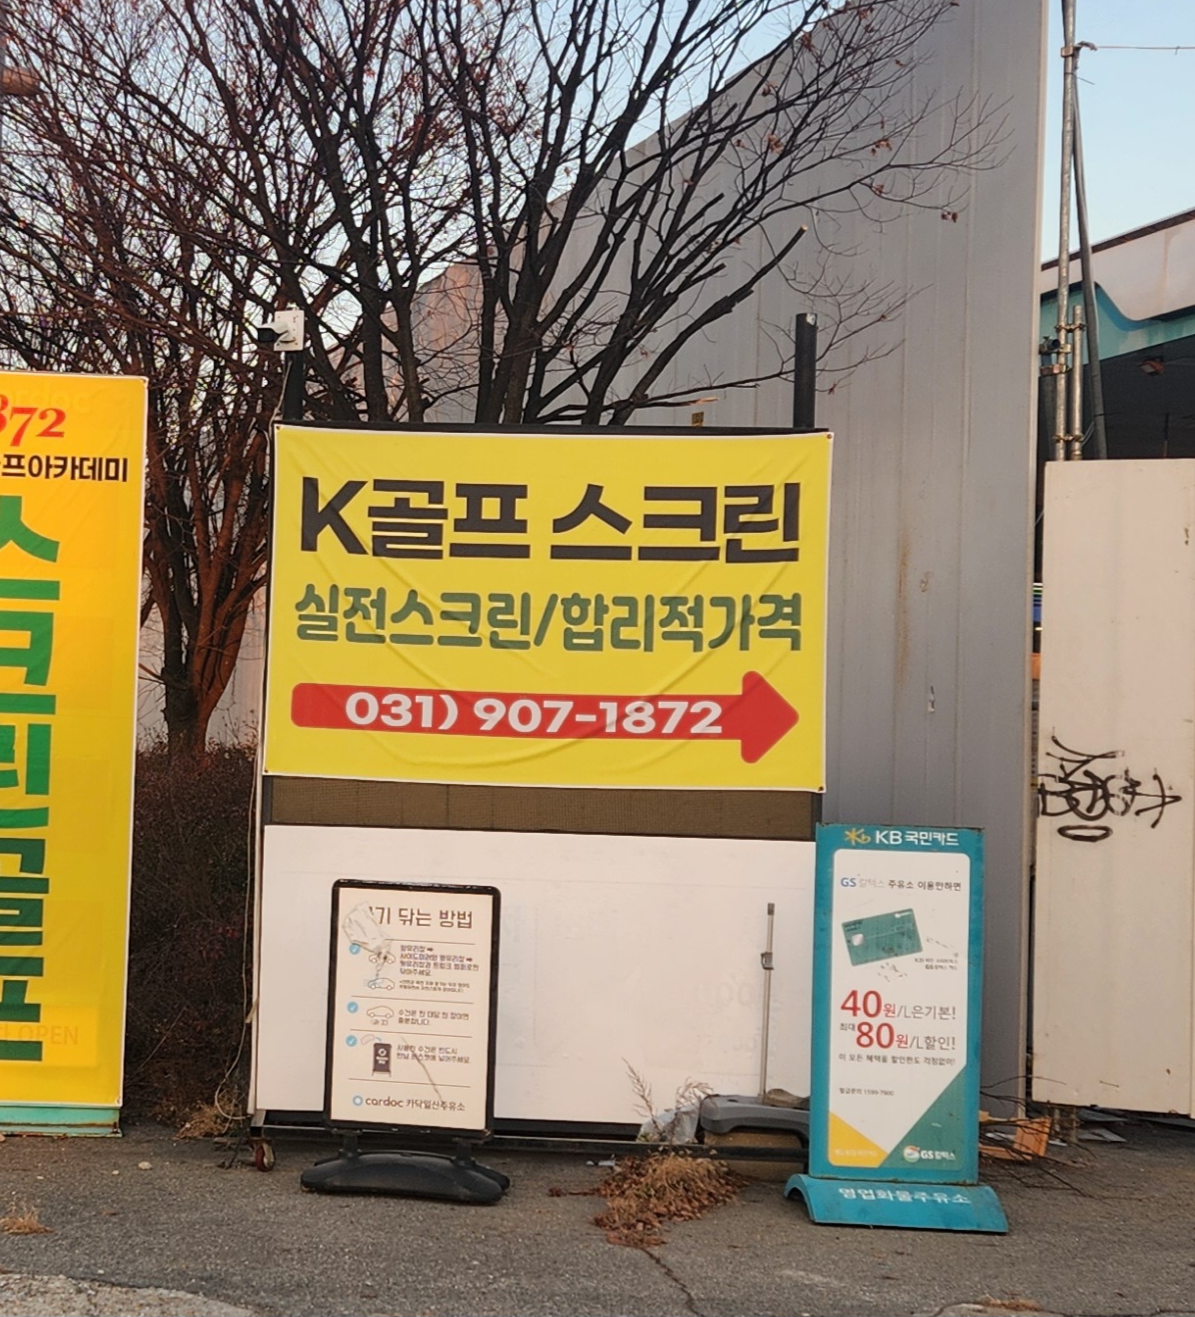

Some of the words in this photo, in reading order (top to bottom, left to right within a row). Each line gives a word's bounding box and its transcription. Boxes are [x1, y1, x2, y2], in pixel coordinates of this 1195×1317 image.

[300, 476, 532, 560] K골프
[549, 482, 802, 564] 스크린
[294, 583, 803, 653] 실전스크린/합리적가격
[346, 691, 459, 731] 031)
[473, 696, 723, 735] 907-1872
[369, 905, 391, 925] 기
[398, 907, 433, 928] 닦는
[439, 909, 473, 930] 방법
[365, 1096, 405, 1109] cardoc
